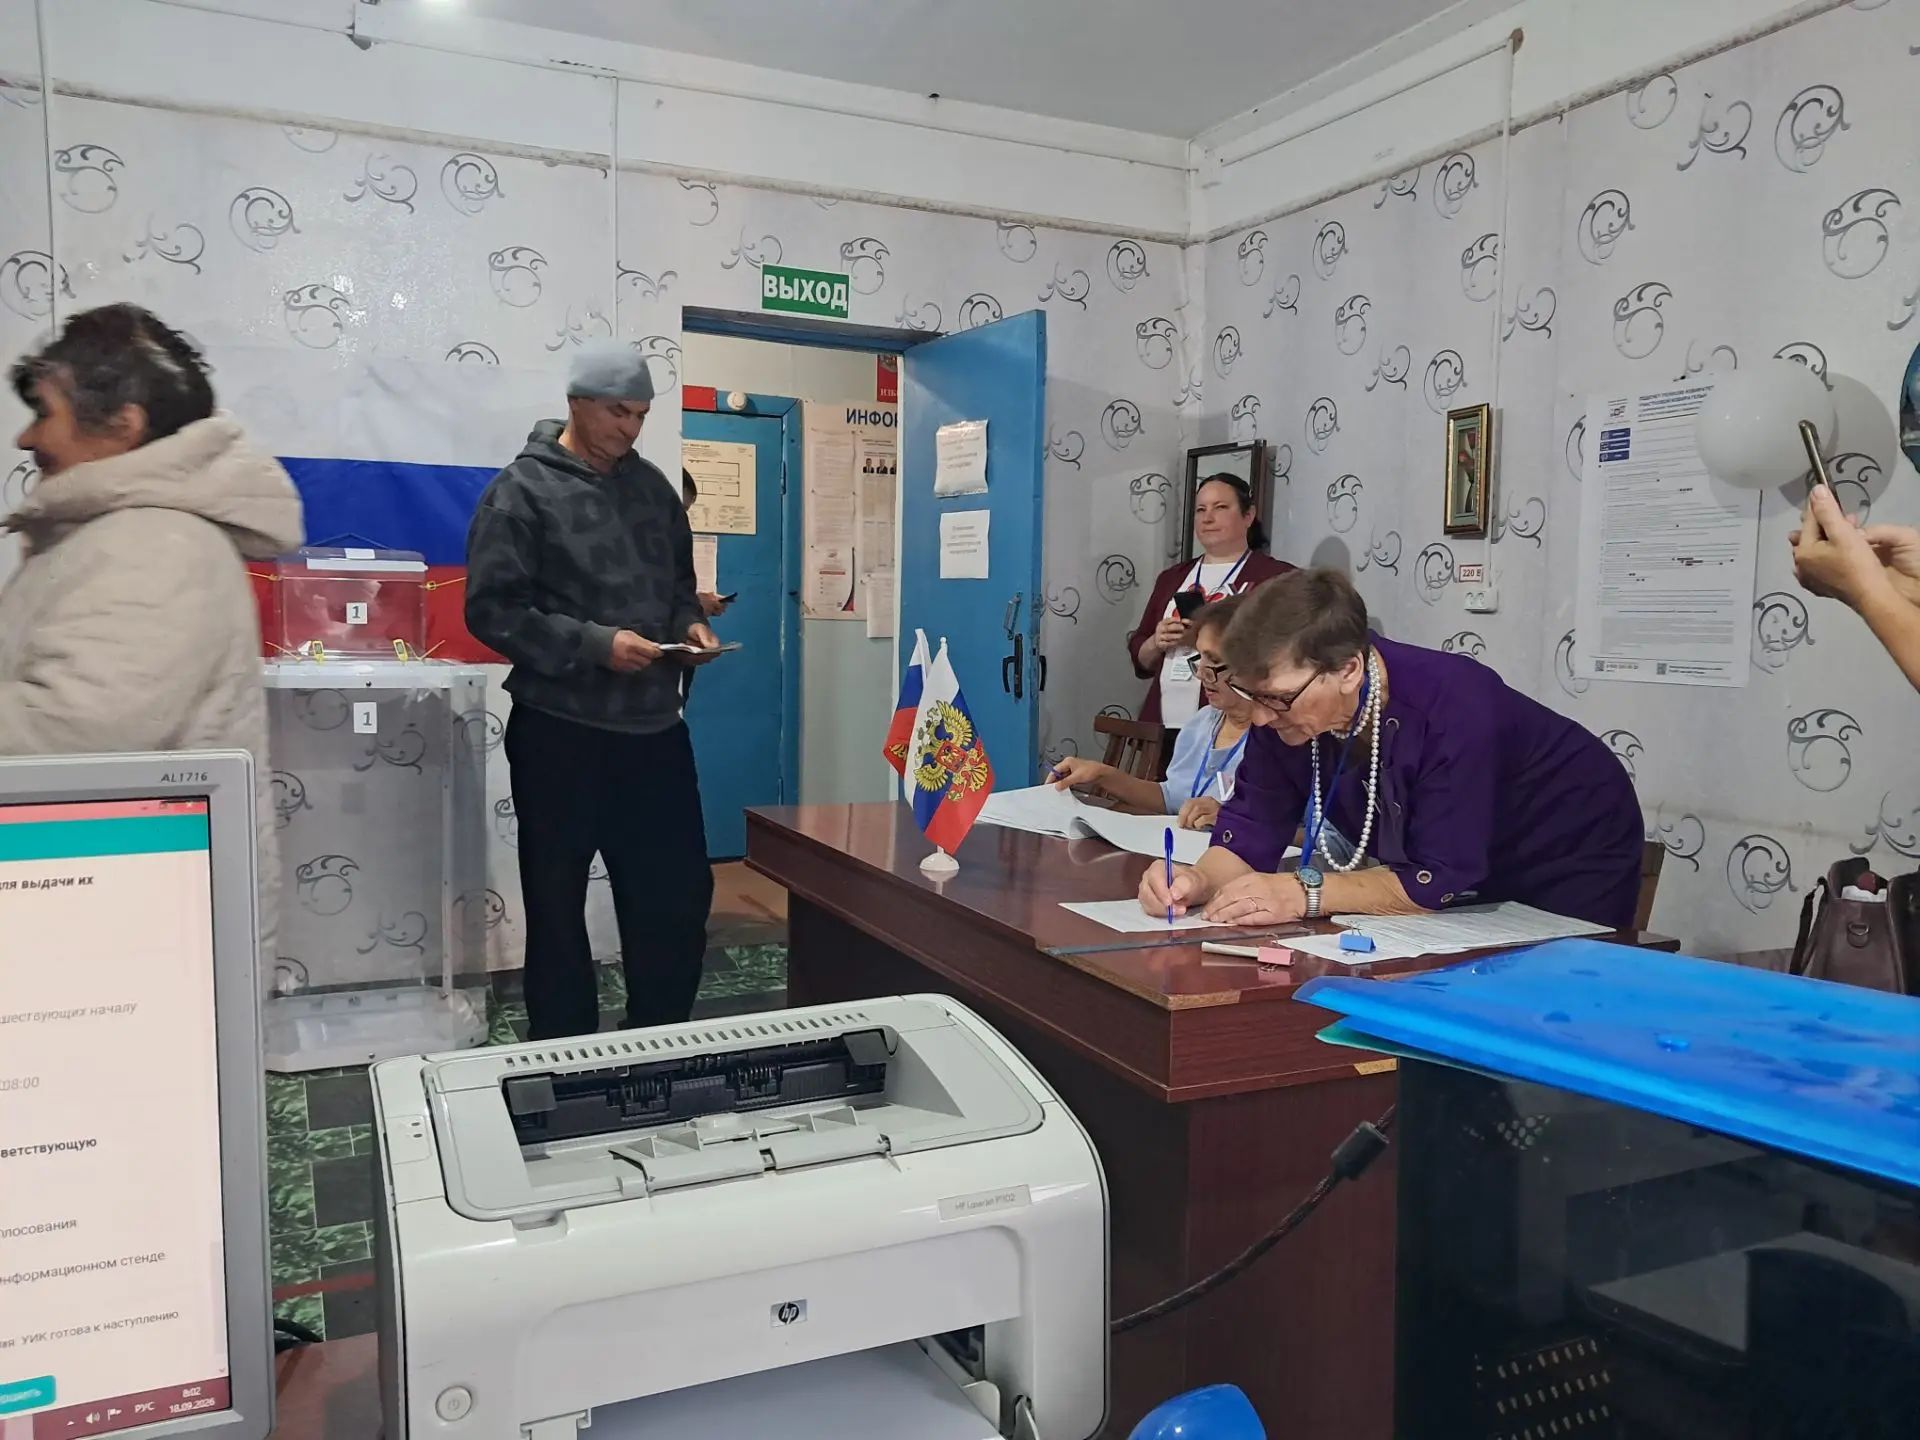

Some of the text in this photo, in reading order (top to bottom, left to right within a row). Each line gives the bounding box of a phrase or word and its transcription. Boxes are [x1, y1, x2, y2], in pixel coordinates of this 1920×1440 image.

[763, 274, 848, 311] ВЫХОД
[1462, 568, 1475, 577] 220
[352, 605, 361, 619] 1
[363, 711, 372, 726] 1
[160, 771, 208, 783] AL1716
[21, 877, 75, 890] выдачи
[78, 875, 94, 886] их
[90, 1001, 138, 1016] началу
[0, 1138, 97, 1158] ветствующую
[120, 1250, 166, 1267] стенде
[781, 1303, 797, 1323] hp
[21, 1331, 48, 1345] УИК
[50, 1325, 92, 1340] готова
[93, 1323, 101, 1332] к
[103, 1310, 179, 1331] наступлению
[134, 1401, 156, 1413] РУС
